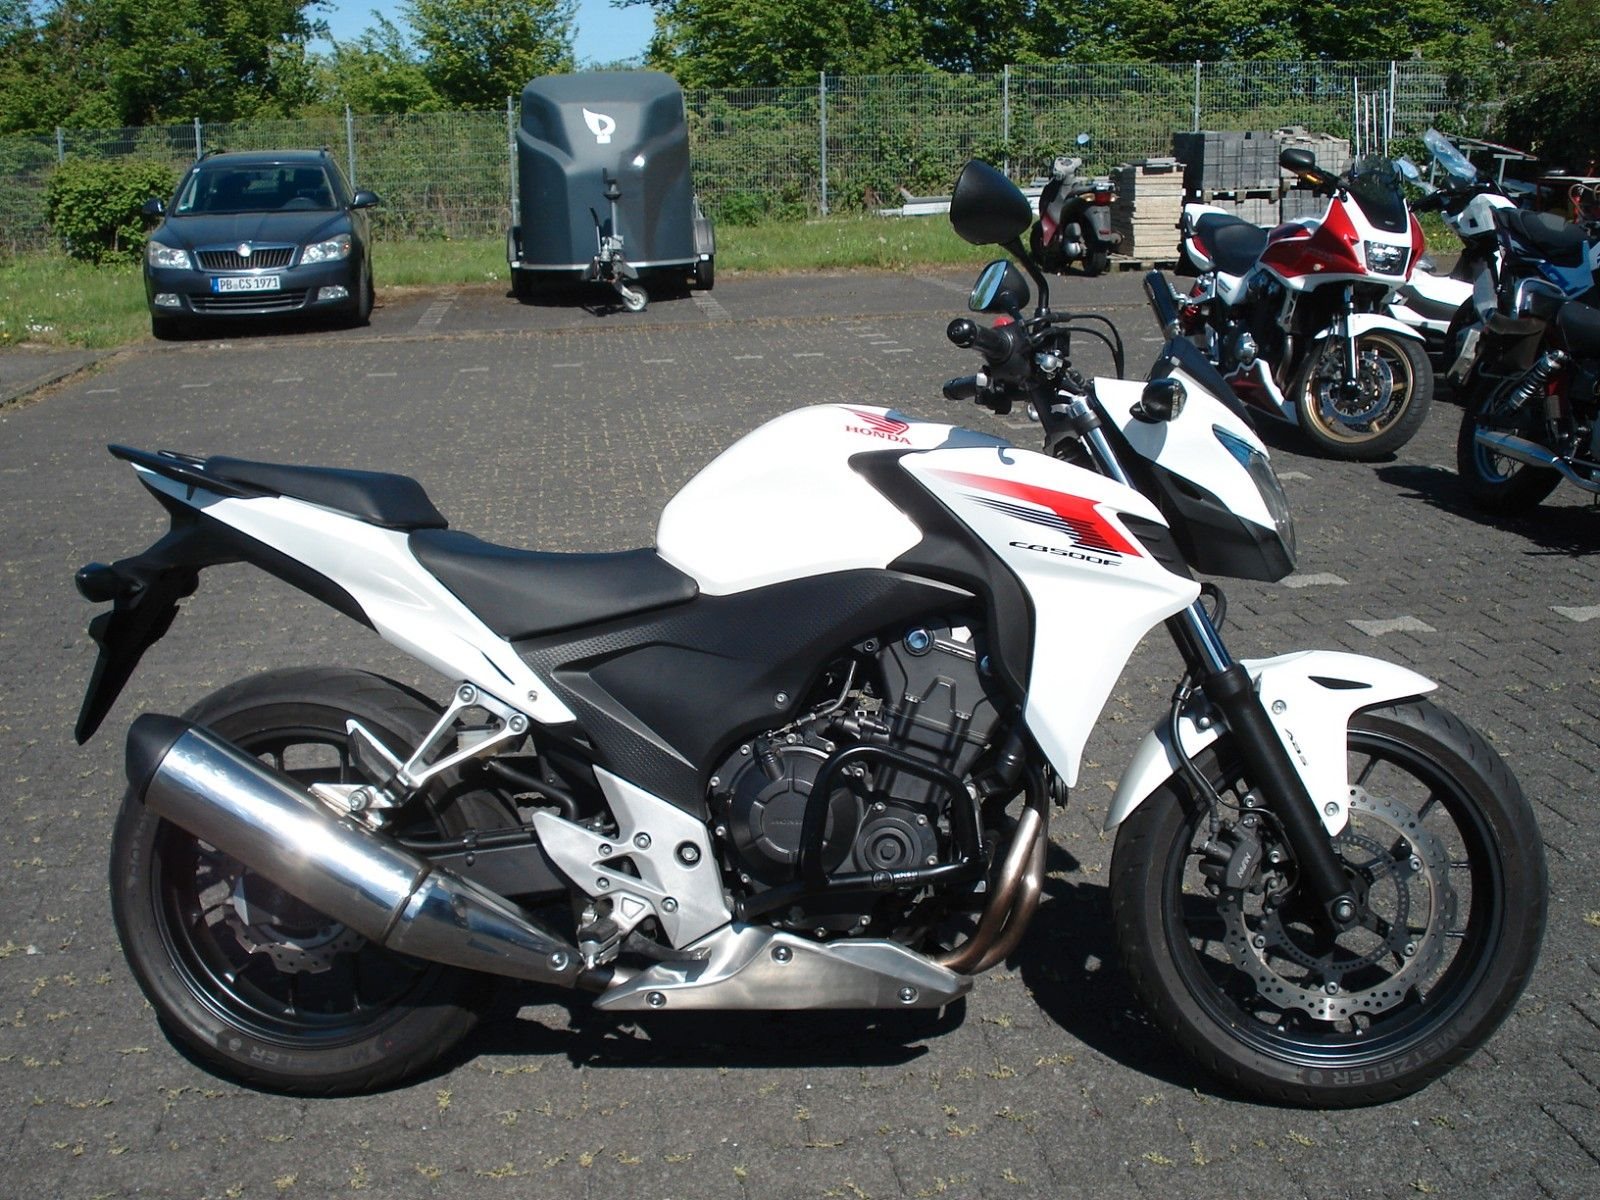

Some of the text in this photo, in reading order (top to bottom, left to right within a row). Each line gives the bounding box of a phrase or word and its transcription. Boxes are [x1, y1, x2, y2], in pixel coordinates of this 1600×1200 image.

[220, 277, 278, 290] PB CS 1971
[845, 425, 912, 445] HONDA
[1009, 541, 1122, 566] CB500F
[1333, 1029, 1460, 1085] METZELER
